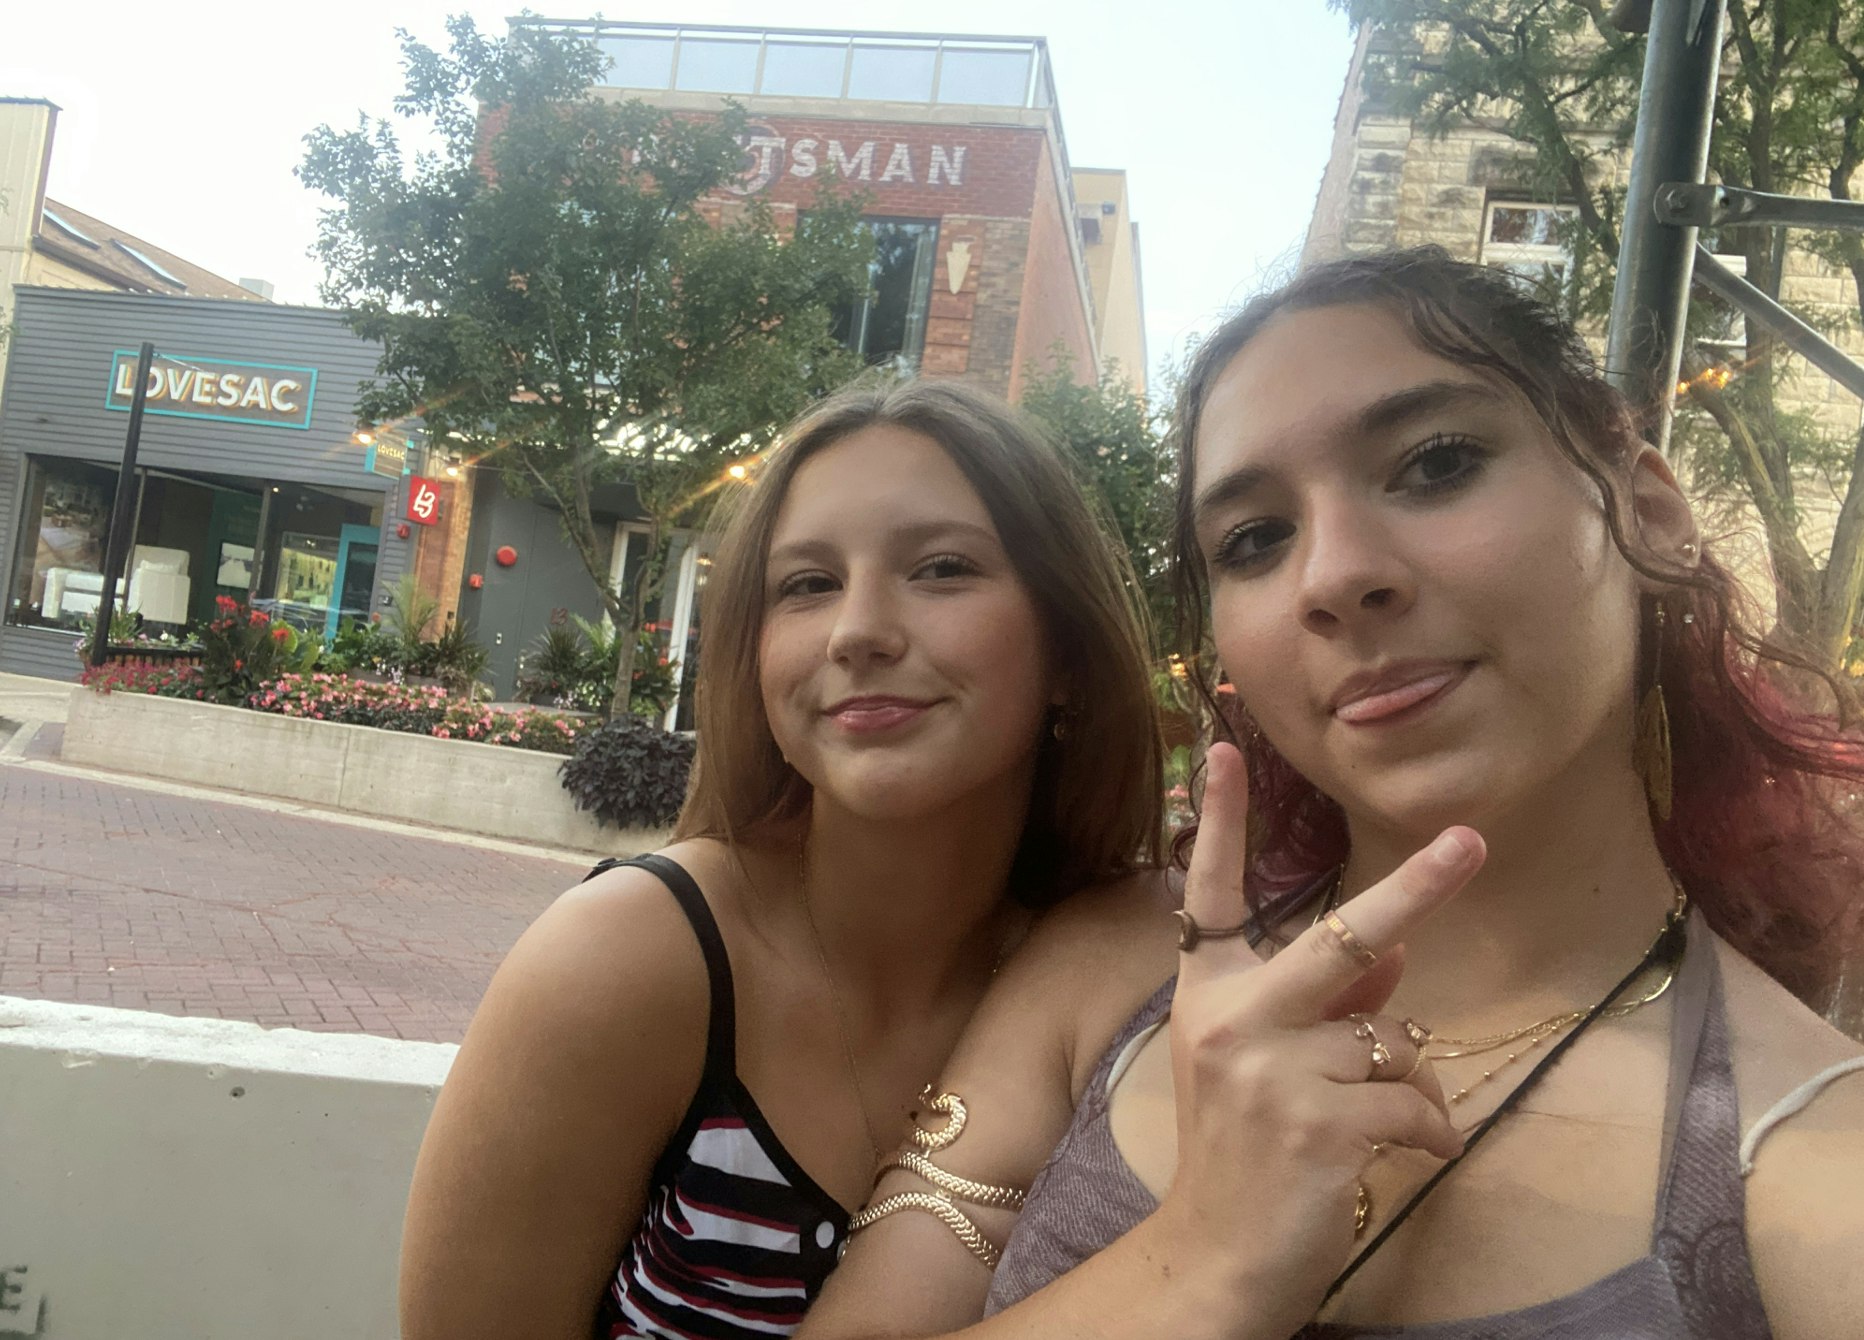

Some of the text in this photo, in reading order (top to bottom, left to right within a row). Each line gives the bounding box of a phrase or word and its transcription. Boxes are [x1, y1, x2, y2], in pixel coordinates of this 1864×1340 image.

[632, 130, 967, 186] TSMAN
[115, 363, 301, 413] LOVESAC
[377, 444, 405, 460] LOVESAC
